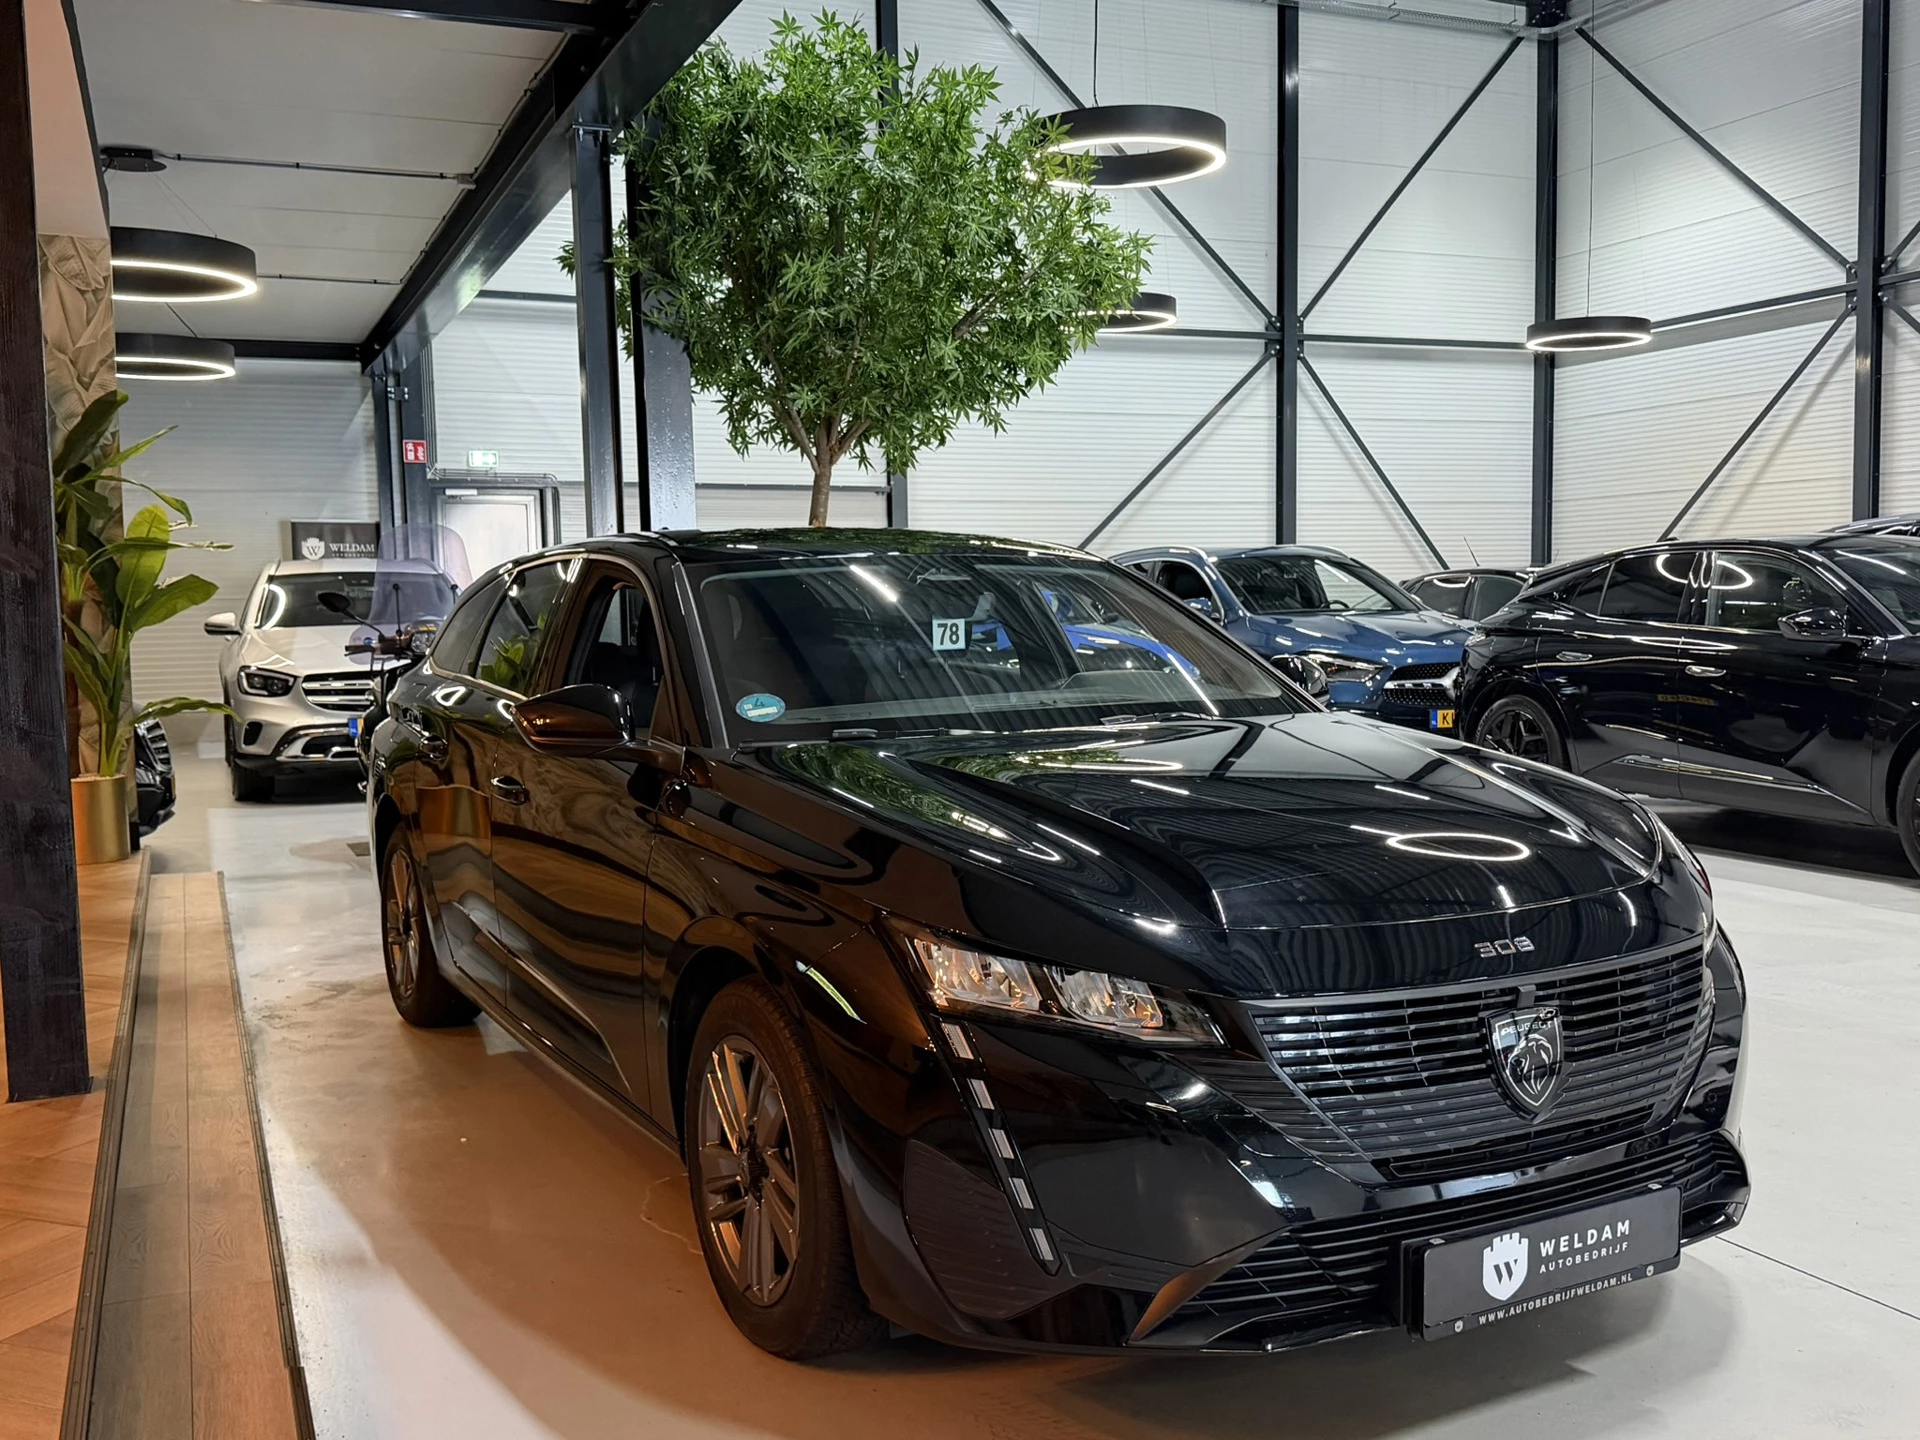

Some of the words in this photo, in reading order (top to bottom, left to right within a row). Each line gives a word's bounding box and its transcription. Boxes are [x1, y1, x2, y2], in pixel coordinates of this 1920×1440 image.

[329, 543, 375, 552] WELDAM
[937, 622, 960, 645] 78
[1474, 936, 1535, 957] 308
[1539, 1219, 1631, 1257] WELDAM
[1539, 1241, 1629, 1274] AUTOBEDRIJF
[1493, 1258, 1519, 1285] W
[1478, 1273, 1633, 1325] WWW.AUTOBEDRIJFWELDAM.NL
